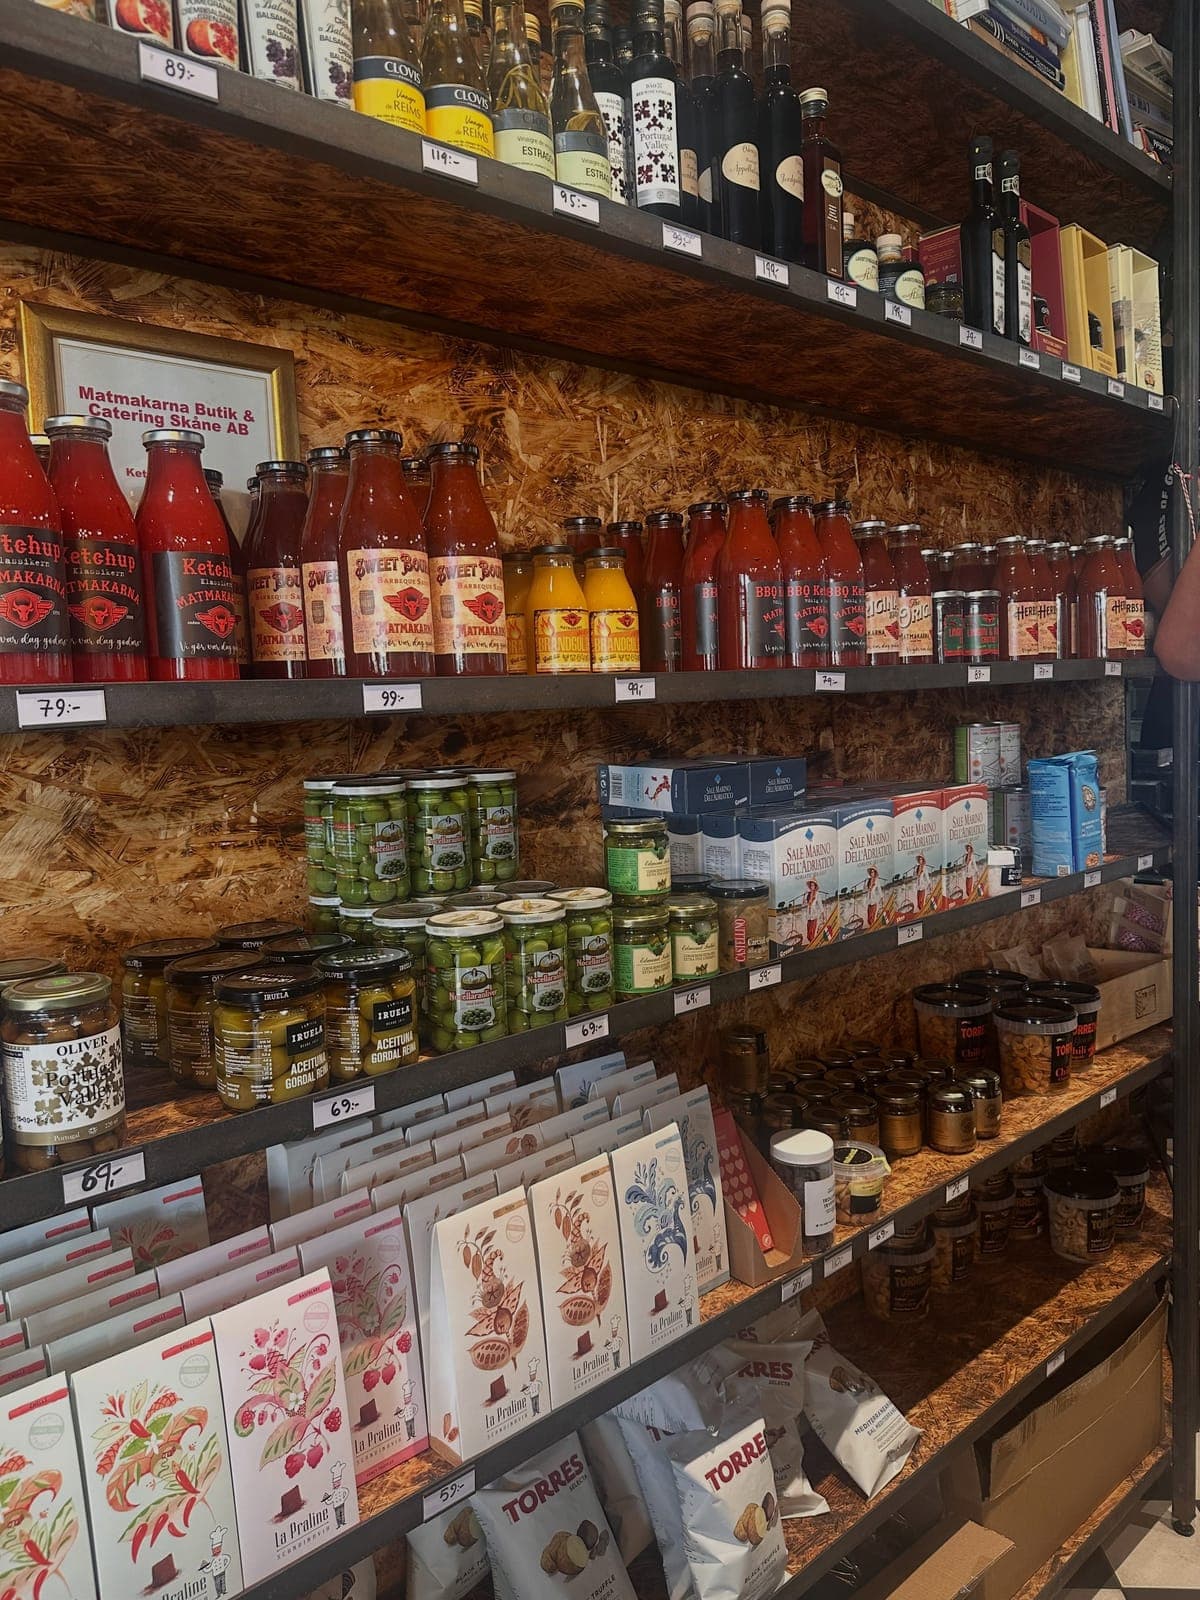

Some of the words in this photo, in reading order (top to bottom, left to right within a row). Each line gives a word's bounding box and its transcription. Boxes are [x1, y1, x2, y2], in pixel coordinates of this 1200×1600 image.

[165, 59, 195, 80] 89:-
[383, 61, 421, 85] CLOVIS
[393, 100, 422, 120] REIMS
[454, 89, 490, 111] CLOVIS
[462, 127, 489, 145] REIMS
[640, 131, 672, 146] Portugal
[431, 148, 460, 166] 119:-
[645, 142, 669, 155] Valley
[560, 189, 588, 209] 95:-
[79, 385, 190, 414] Matmakarna
[195, 402, 237, 422] Butik
[243, 409, 255, 424] &
[88, 403, 165, 428] Catering
[170, 414, 222, 433] Skåne
[227, 421, 249, 437] AB
[1161, 490, 1169, 509] OF
[355, 557, 399, 581] SWEET
[436, 563, 478, 587] SWEET
[756, 585, 778, 599] BBQ
[788, 585, 811, 599] BBQ
[656, 597, 679, 609] BBQ
[36, 698, 82, 717] 79:-
[381, 690, 405, 707] 99:-
[952, 815, 964, 828] SALE
[964, 812, 984, 825] MARINO
[901, 824, 915, 839] SALE
[915, 822, 937, 836] MARINO
[848, 835, 865, 850] SALE
[865, 832, 890, 848] MARINO
[897, 833, 940, 852] DELL'ADRIATICO
[786, 847, 804, 862] SALE
[805, 842, 831, 858] MARINO
[845, 845, 893, 865] DELL'ADRIATICO
[781, 856, 835, 878] DELL'ADRIATICO
[735, 918, 746, 963] CASTELLINO
[264, 991, 290, 1002] IRUELA
[377, 1005, 411, 1022] IRUELA
[291, 1024, 324, 1044] IRUELA
[581, 1022, 603, 1037] 69:-
[57, 1035, 109, 1057] OLIVER
[376, 1030, 415, 1051] ACEITUNA
[290, 1052, 327, 1076] ACEITUNA
[371, 1047, 402, 1065] GORDAL
[45, 1059, 120, 1089] Portugal
[285, 1071, 316, 1090] GORDAL
[330, 1098, 360, 1117] 69:-
[54, 1133, 81, 1143] Portugal
[650, 1322, 659, 1336] La
[659, 1308, 683, 1331] Praline
[572, 1366, 582, 1380] La
[582, 1350, 609, 1375] Praline
[485, 1413, 496, 1429] La
[496, 1395, 527, 1423] Praline
[354, 1438, 365, 1455] La
[366, 1419, 402, 1449] Praline
[704, 1431, 768, 1492] TORRE
[439, 1481, 465, 1503] 59:-
[502, 1453, 584, 1524] TORRES
[568, 1474, 588, 1493] SELECTA
[274, 1528, 287, 1549] La
[287, 1505, 330, 1542] Praline
